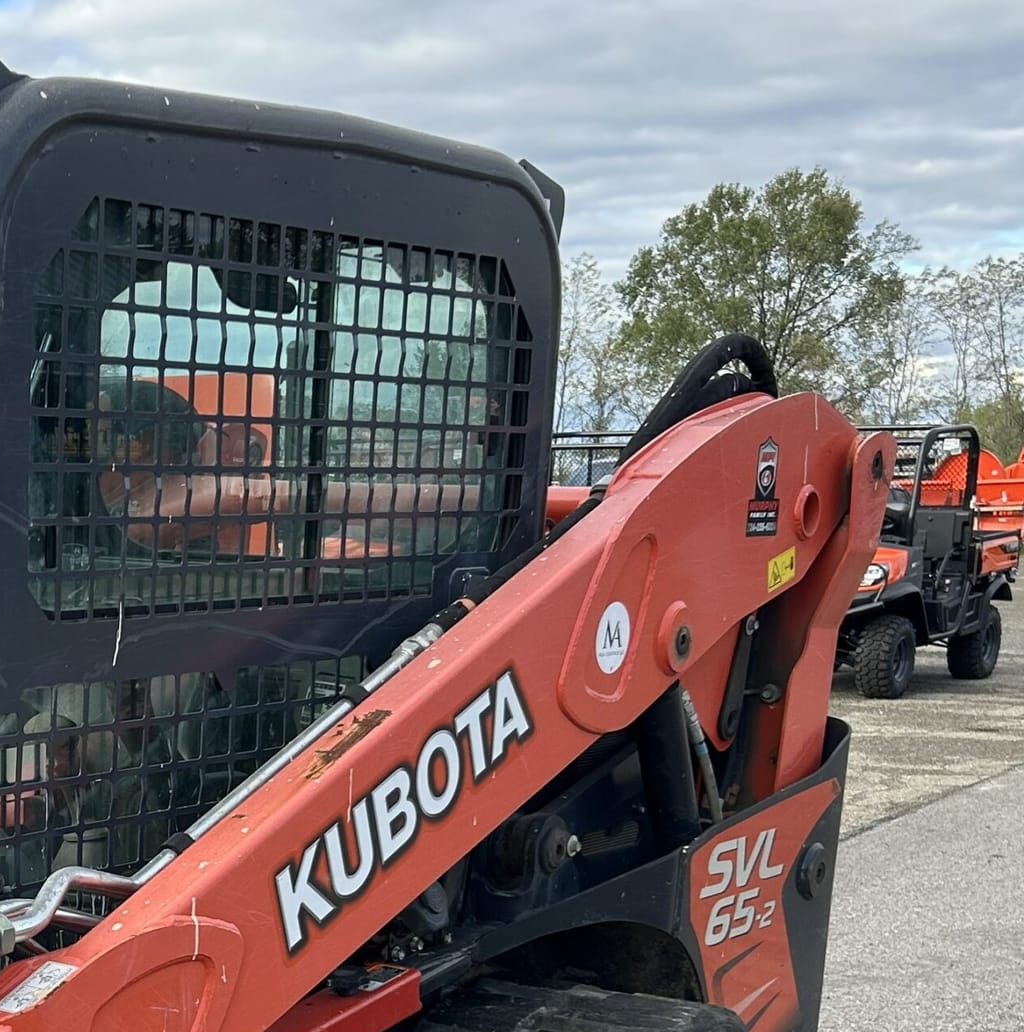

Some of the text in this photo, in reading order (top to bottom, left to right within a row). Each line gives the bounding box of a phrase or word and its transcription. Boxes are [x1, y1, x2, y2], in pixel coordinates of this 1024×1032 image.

[273, 669, 531, 955] KUBOTA
[699, 827, 785, 900] SVL
[704, 886, 776, 946] 65-2
